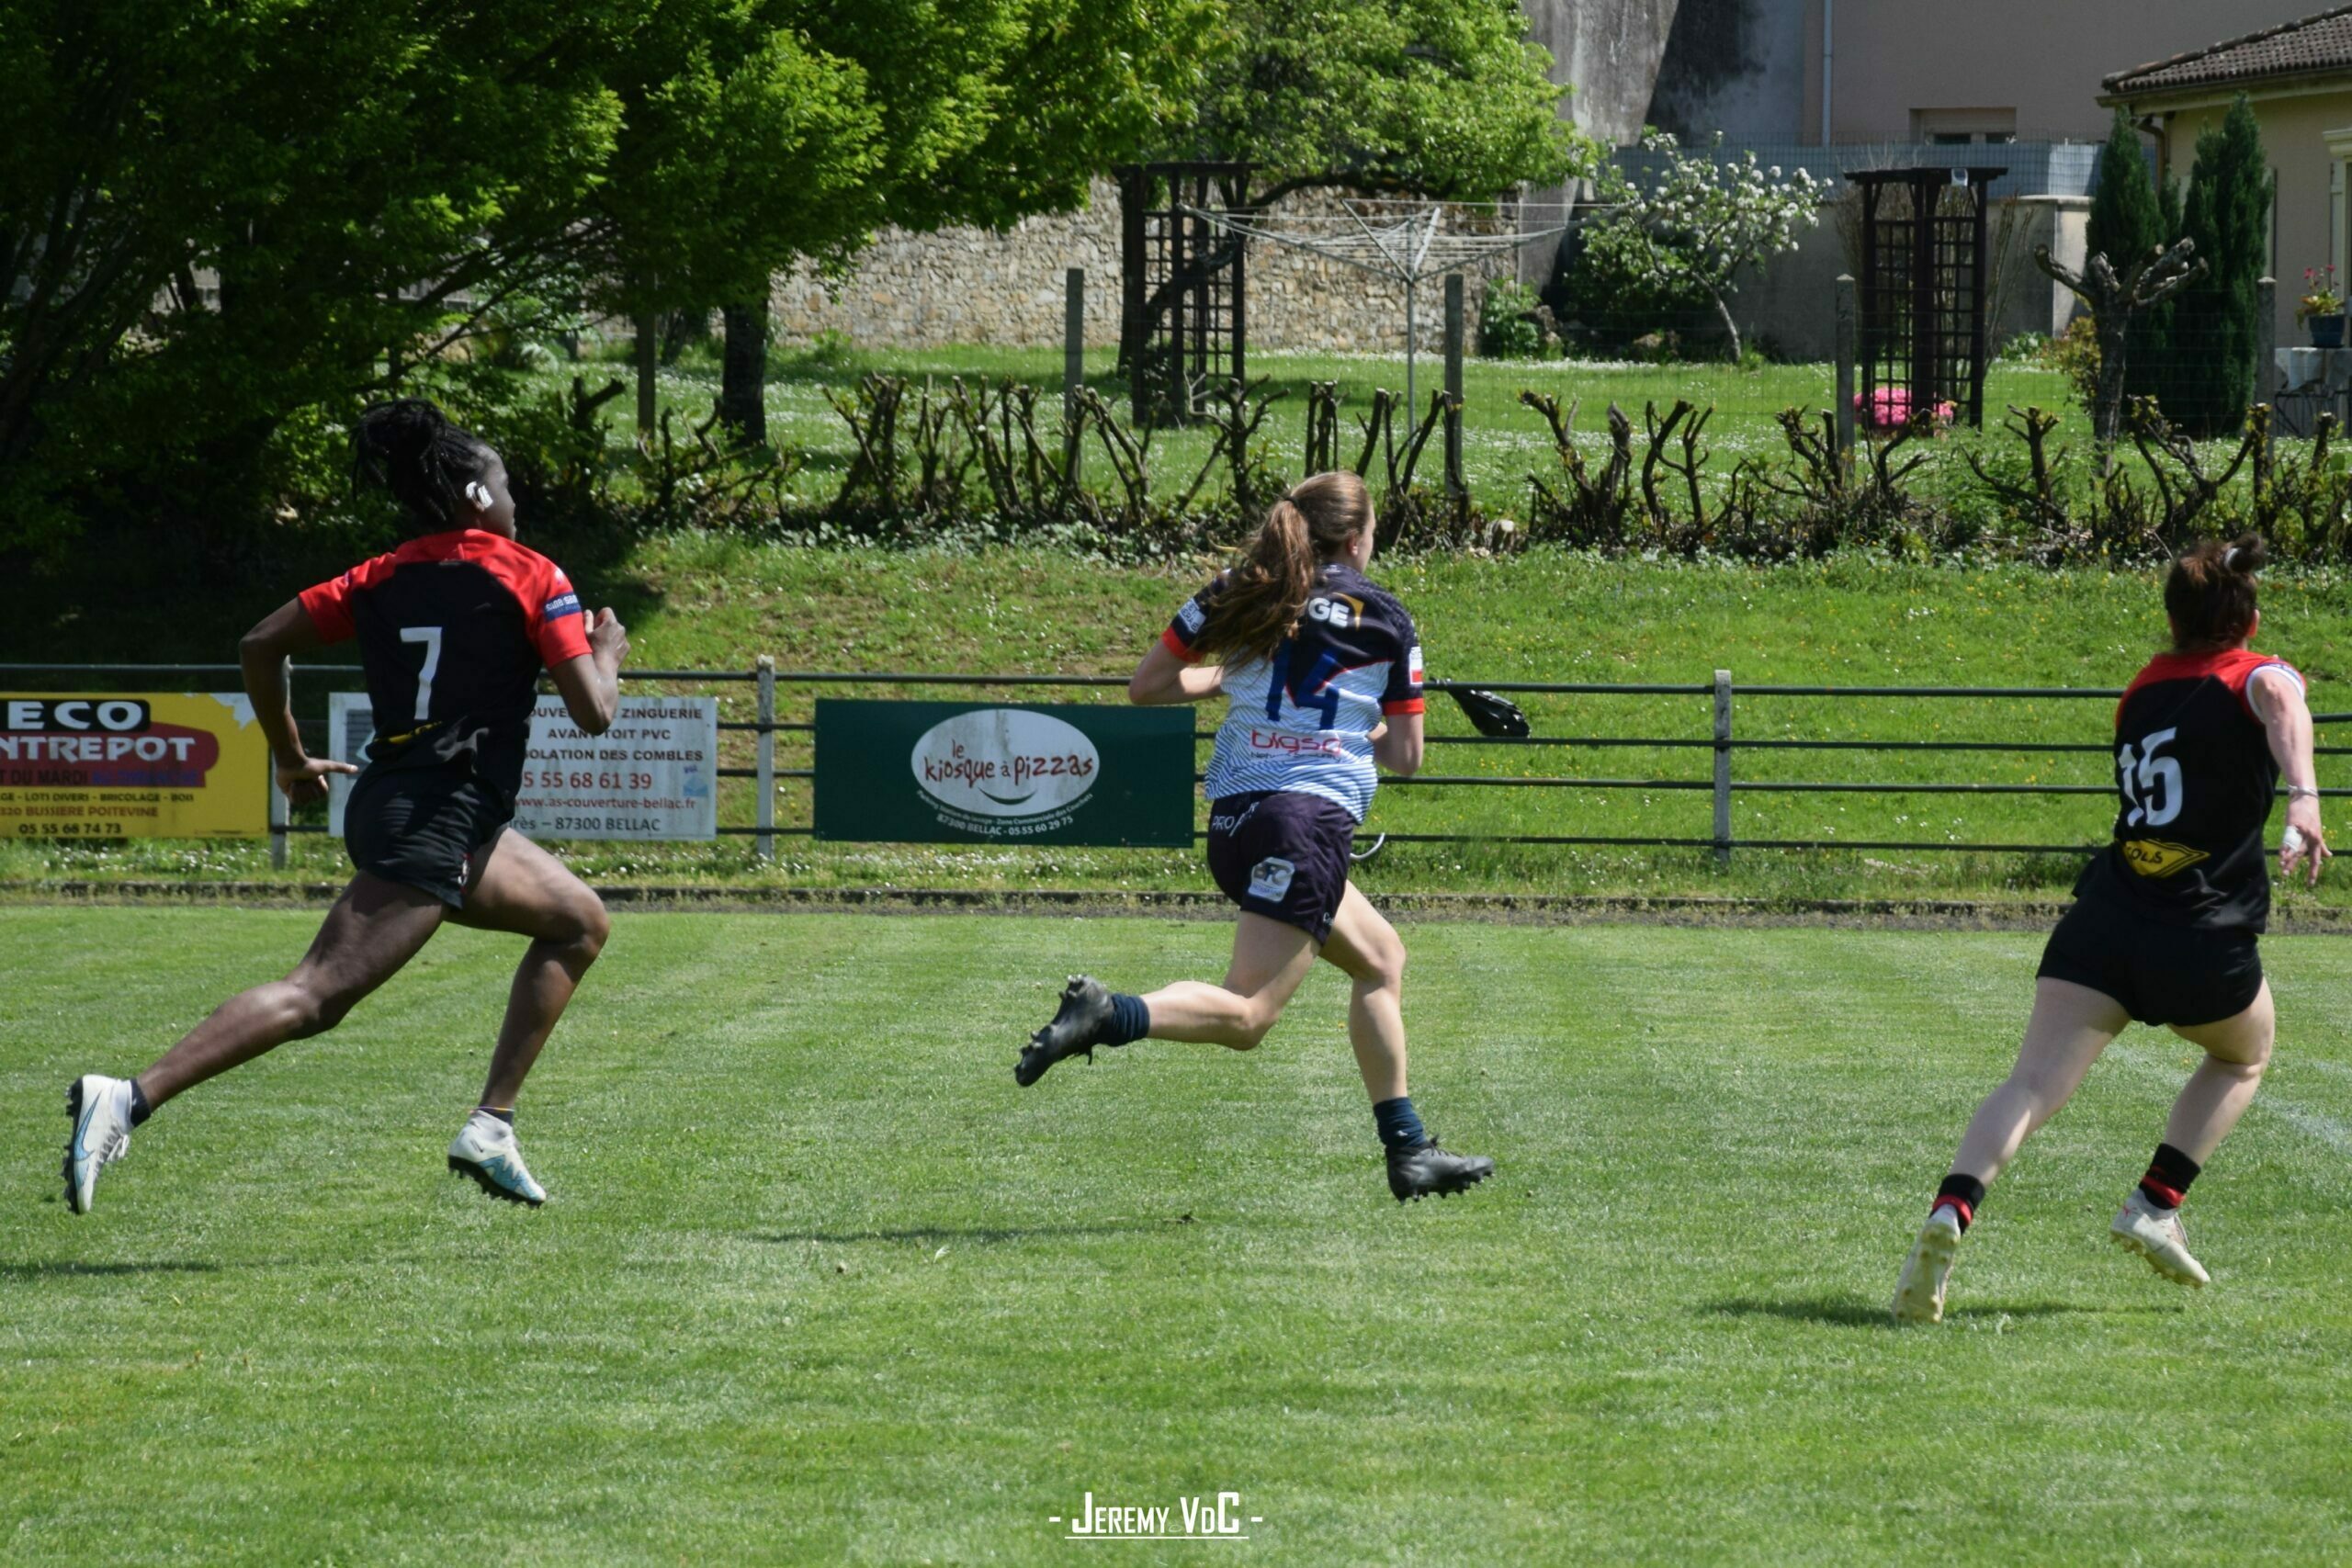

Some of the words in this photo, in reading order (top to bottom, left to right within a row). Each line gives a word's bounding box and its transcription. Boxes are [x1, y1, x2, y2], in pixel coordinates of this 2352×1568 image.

[400, 626, 442, 720] 7
[1265, 637, 1340, 730] 14
[7, 701, 143, 731] ECO
[621, 708, 703, 719] ZINGUERIE
[604, 728, 636, 739] TOIT
[641, 729, 672, 740] PVC
[0, 736, 196, 763] NTREPOT
[525, 749, 595, 761] OLATION
[599, 750, 628, 761] DES
[633, 750, 704, 761] COMBLES
[951, 739, 965, 759] le
[11, 770, 33, 785] DU
[37, 770, 88, 785] MARDI
[924, 756, 996, 789] kiosque
[1001, 761, 1012, 777] à
[1014, 754, 1093, 786] pizzas
[2118, 727, 2184, 828] 15
[523, 772, 534, 788] 5
[540, 773, 563, 789] 55
[570, 773, 593, 789] 68
[599, 773, 622, 790] 61
[628, 773, 653, 790] 39
[100, 792, 161, 803] BRICOLAGE
[26, 806, 85, 818] BUSSIERE
[88, 806, 159, 818] POITEVINE
[18, 823, 38, 835] 05
[41, 823, 59, 835] 55
[84, 823, 101, 835] 74
[105, 823, 122, 835] 73
[555, 817, 602, 830] 87300
[605, 818, 662, 831] BELLAC
[967, 823, 1002, 836] BELLAC
[1008, 827, 1021, 836] 05
[1021, 826, 1034, 835] 55
[1035, 824, 1047, 833] 60
[1047, 820, 1061, 830] 29
[1061, 816, 1074, 827] 75
